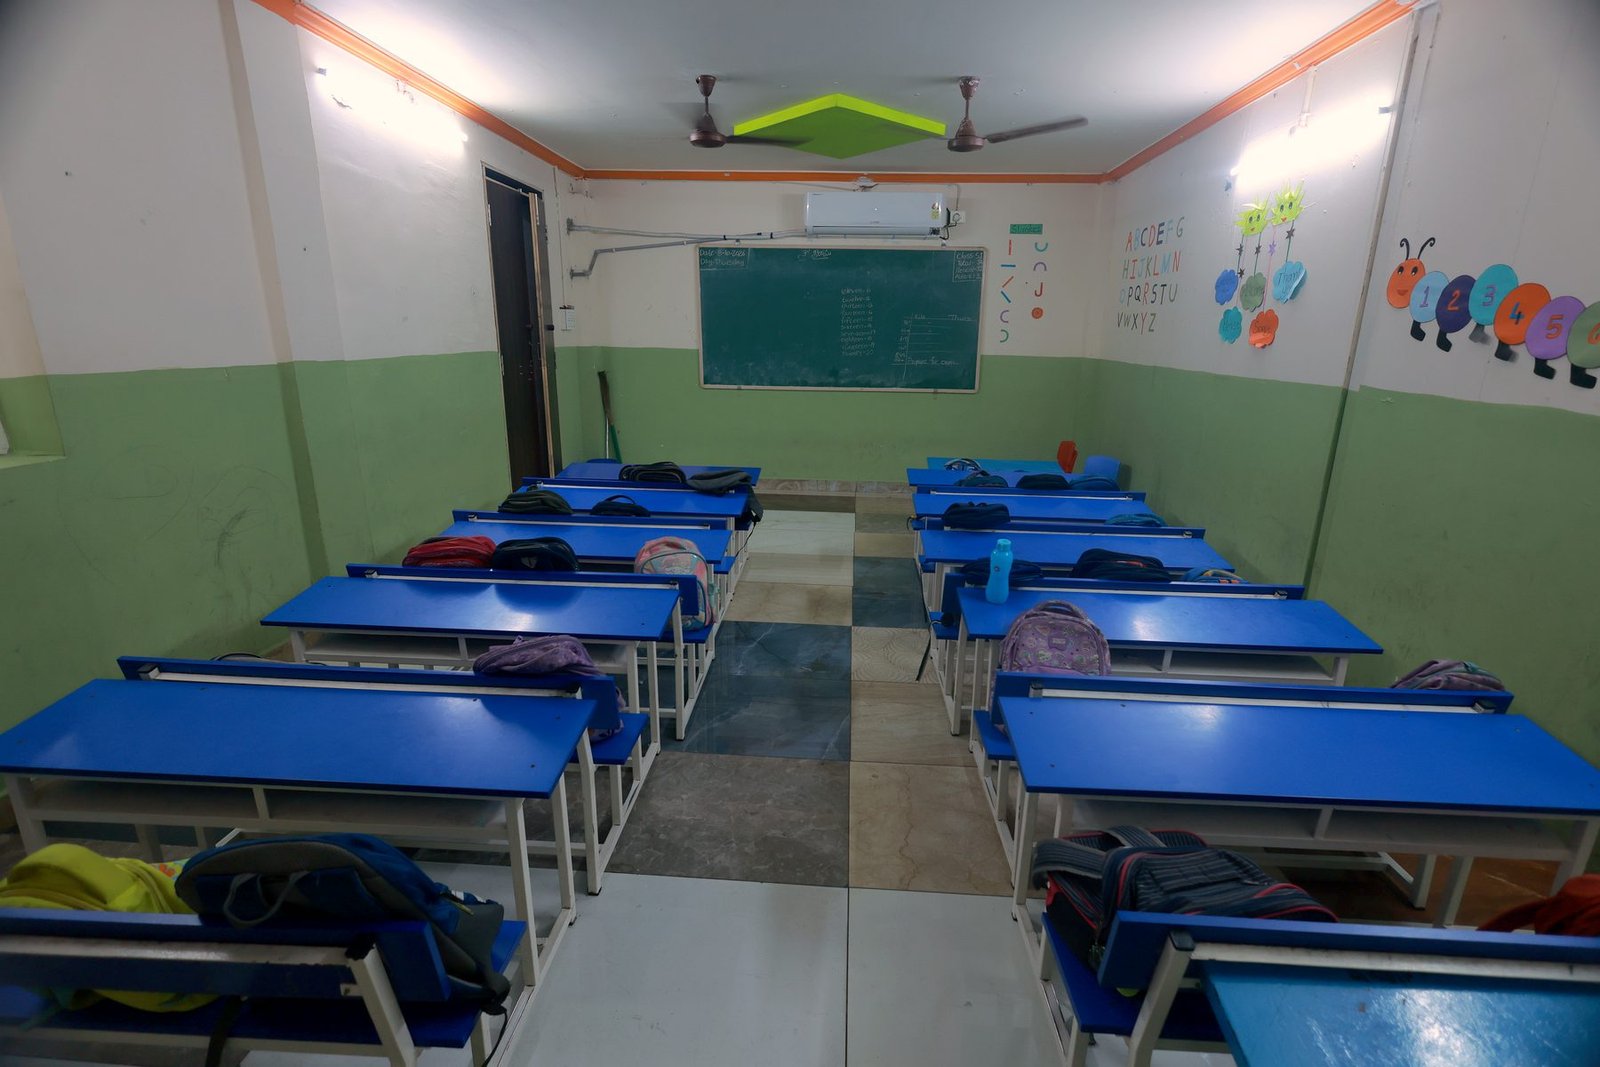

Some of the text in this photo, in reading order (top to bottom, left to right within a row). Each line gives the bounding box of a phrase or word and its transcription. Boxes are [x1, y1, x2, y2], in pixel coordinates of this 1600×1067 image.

[1420, 286, 1430, 308] 1
[1447, 289, 1460, 311] 2
[1482, 285, 1498, 306] 3
[1509, 302, 1525, 325] 4
[1545, 314, 1564, 340] 5
